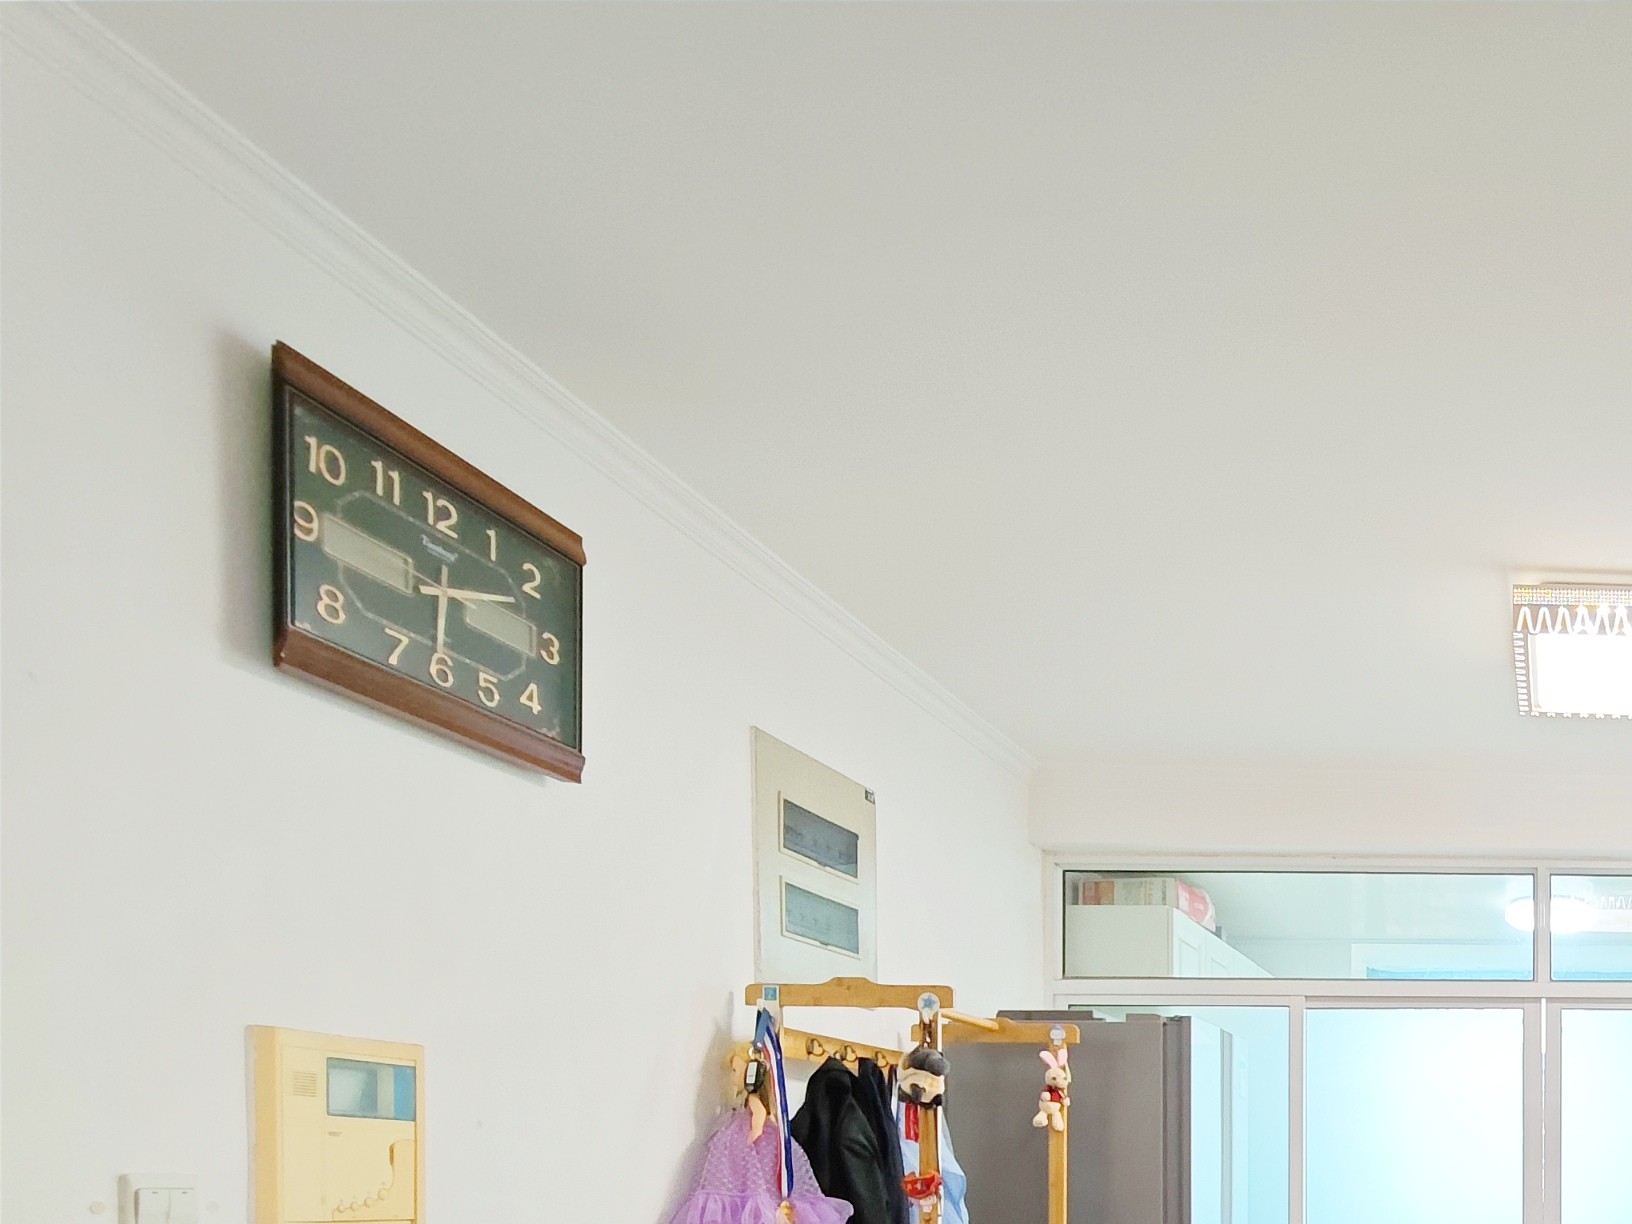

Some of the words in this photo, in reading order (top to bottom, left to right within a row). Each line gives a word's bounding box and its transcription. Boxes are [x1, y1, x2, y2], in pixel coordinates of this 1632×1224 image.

[304, 434, 346, 486] 10
[370, 460, 402, 506] 11
[293, 500, 319, 542] 9
[422, 491, 459, 539] 12
[486, 529, 497, 561] 1
[522, 562, 542, 600] 2
[317, 584, 345, 624] 8
[384, 628, 409, 665] 7
[541, 633, 560, 665] 3
[429, 652, 454, 688] 6
[478, 672, 500, 708] 5
[519, 682, 542, 714] 4
